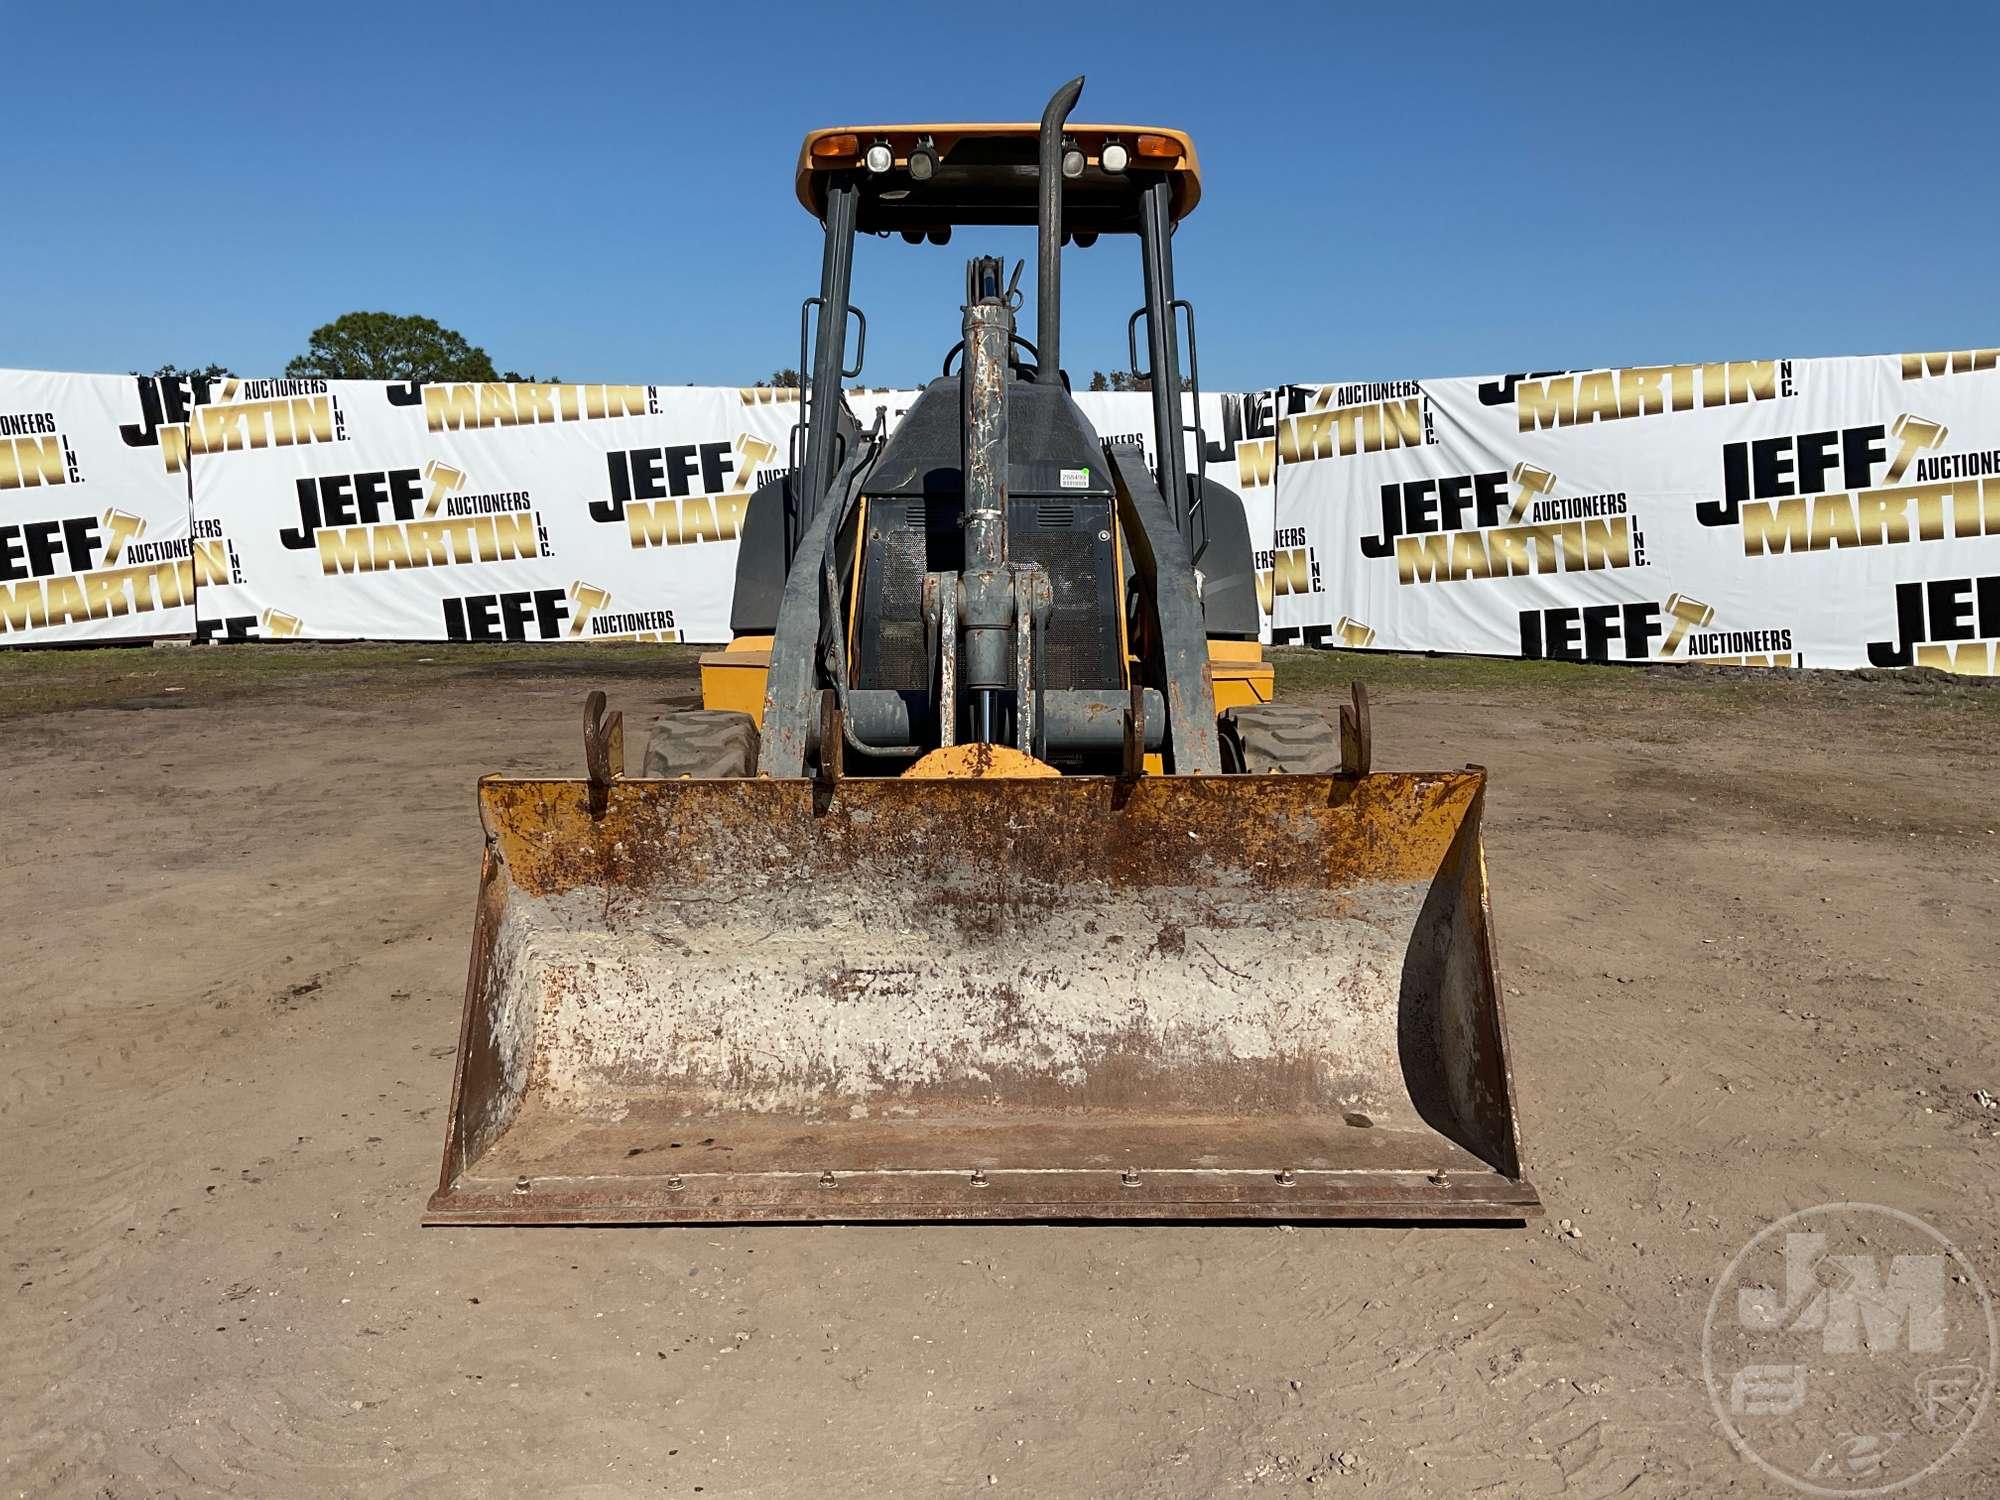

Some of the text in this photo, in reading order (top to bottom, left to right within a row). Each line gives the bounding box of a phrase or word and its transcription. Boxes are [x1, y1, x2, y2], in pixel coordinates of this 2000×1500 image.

[244, 379, 328, 400] AUCTIONEERS
[424, 383, 645, 432] MARTIN
[1338, 380, 1420, 406] AUCTIONEERS
[1518, 361, 1775, 432] MARTIN
[332, 395, 352, 442] INC.
[62, 434, 85, 483] INC.
[588, 442, 734, 523] JEFF
[1696, 424, 1887, 527] JEFF
[280, 469, 424, 550] JEFF
[447, 491, 531, 516] AUCTIONEERS
[1360, 472, 1509, 558] JEFF
[1533, 493, 1627, 522] AUCTIONEERS
[317, 513, 538, 576] MARTIN
[536, 511, 555, 557] INC.
[1396, 517, 1630, 585] MARTIN
[1632, 515, 1651, 567] INC.
[228, 539, 247, 584] INC.
[1310, 547, 1325, 592] INC.
[593, 611, 675, 635] AUCTIONEERS
[1689, 629, 1792, 656] AUCTIONEERS
